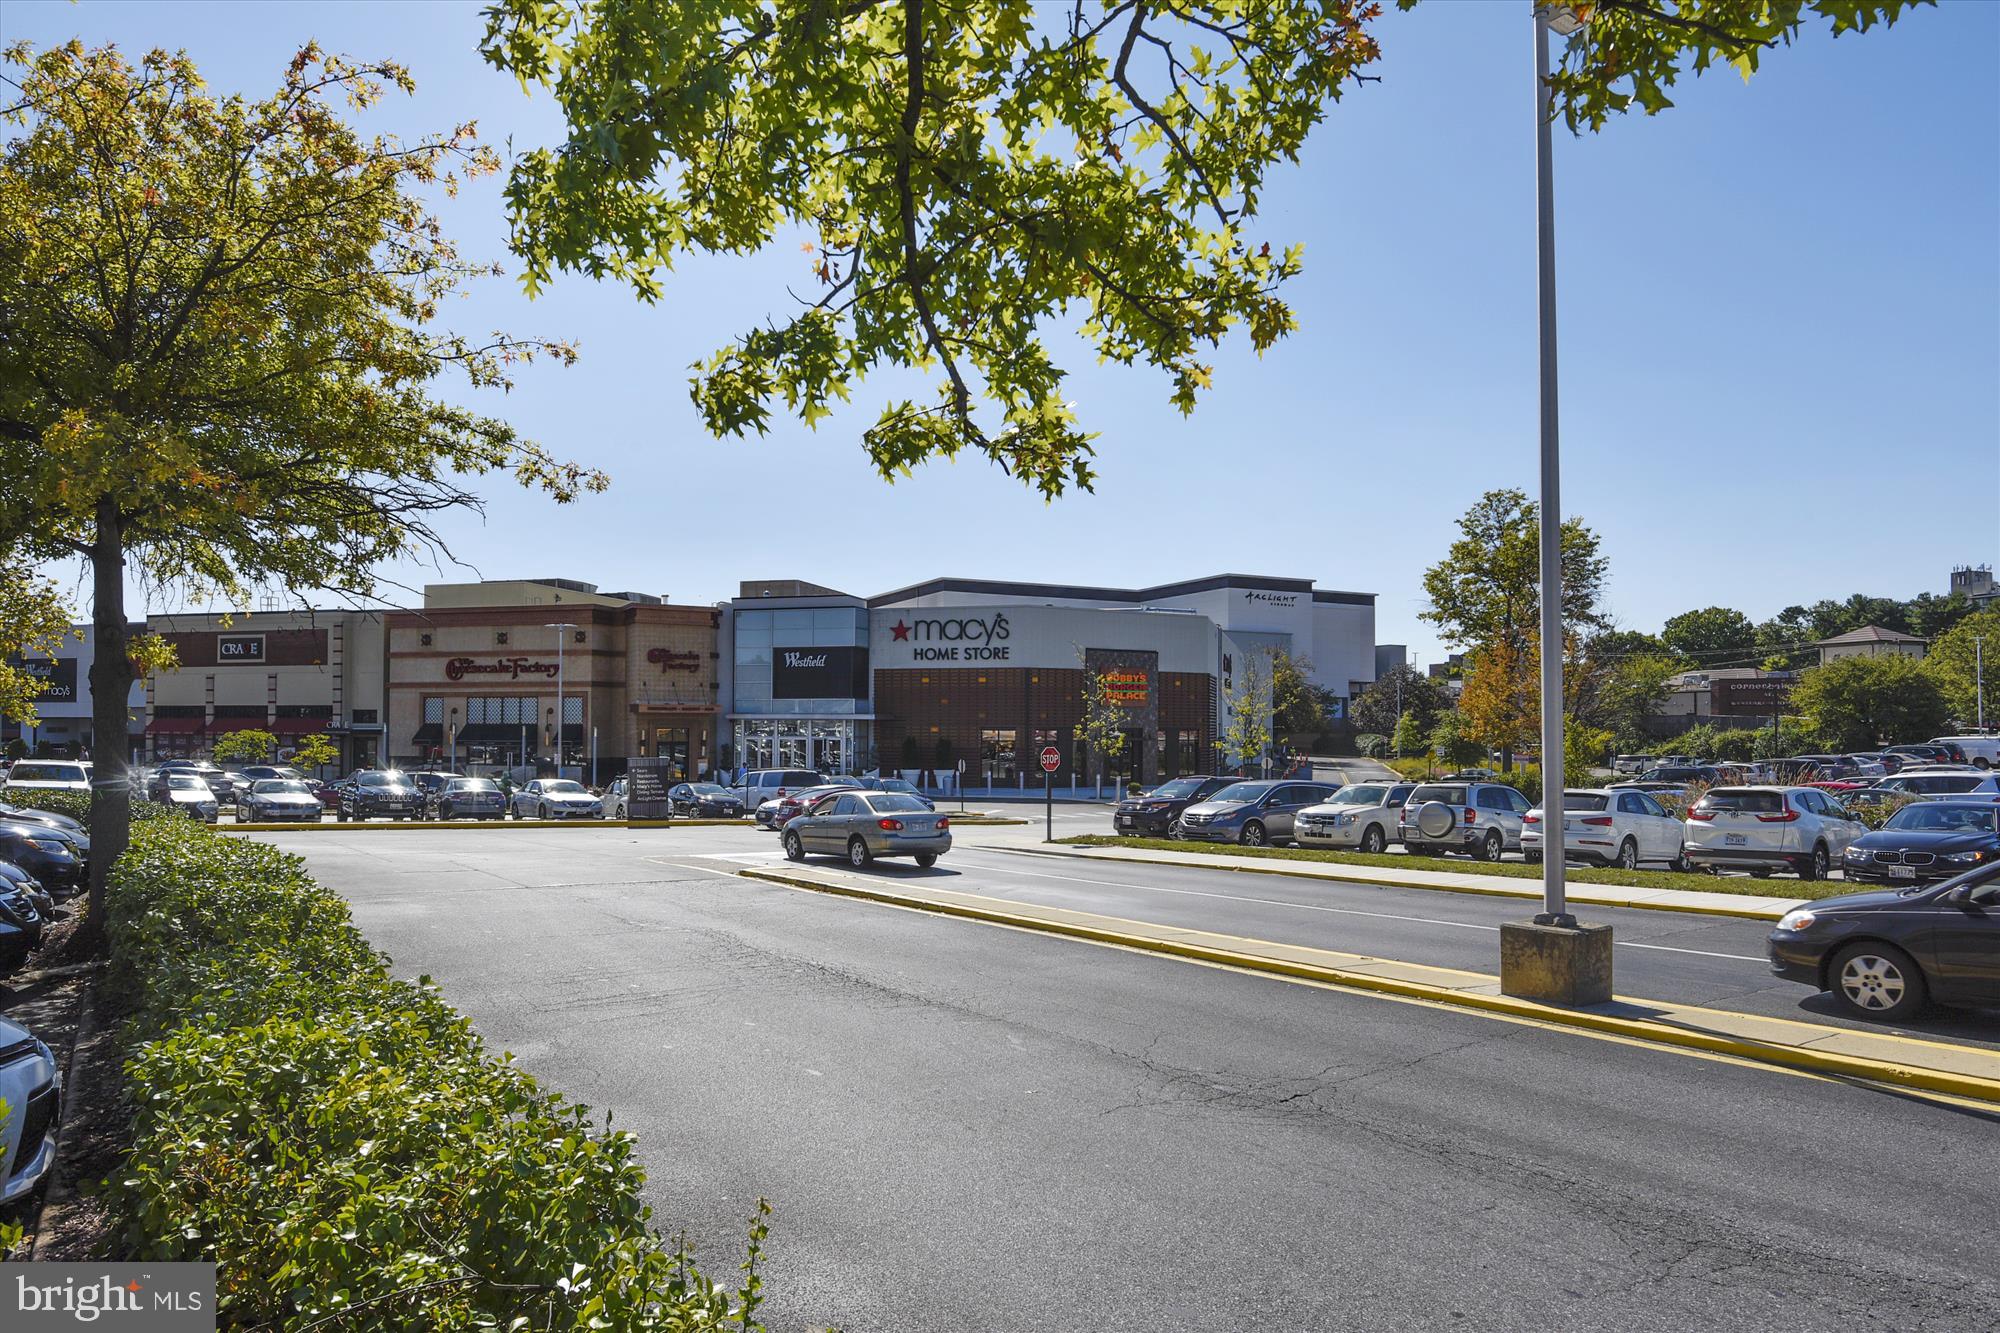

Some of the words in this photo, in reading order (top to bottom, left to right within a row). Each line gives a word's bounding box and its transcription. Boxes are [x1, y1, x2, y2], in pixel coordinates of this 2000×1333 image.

[914, 612, 1010, 646] macy's
[784, 651, 827, 668] Westfield
[914, 647, 958, 661] HOME
[964, 646, 1009, 660] STORE
[506, 658, 560, 679] Factory
[1042, 754, 1059, 764] STOP
